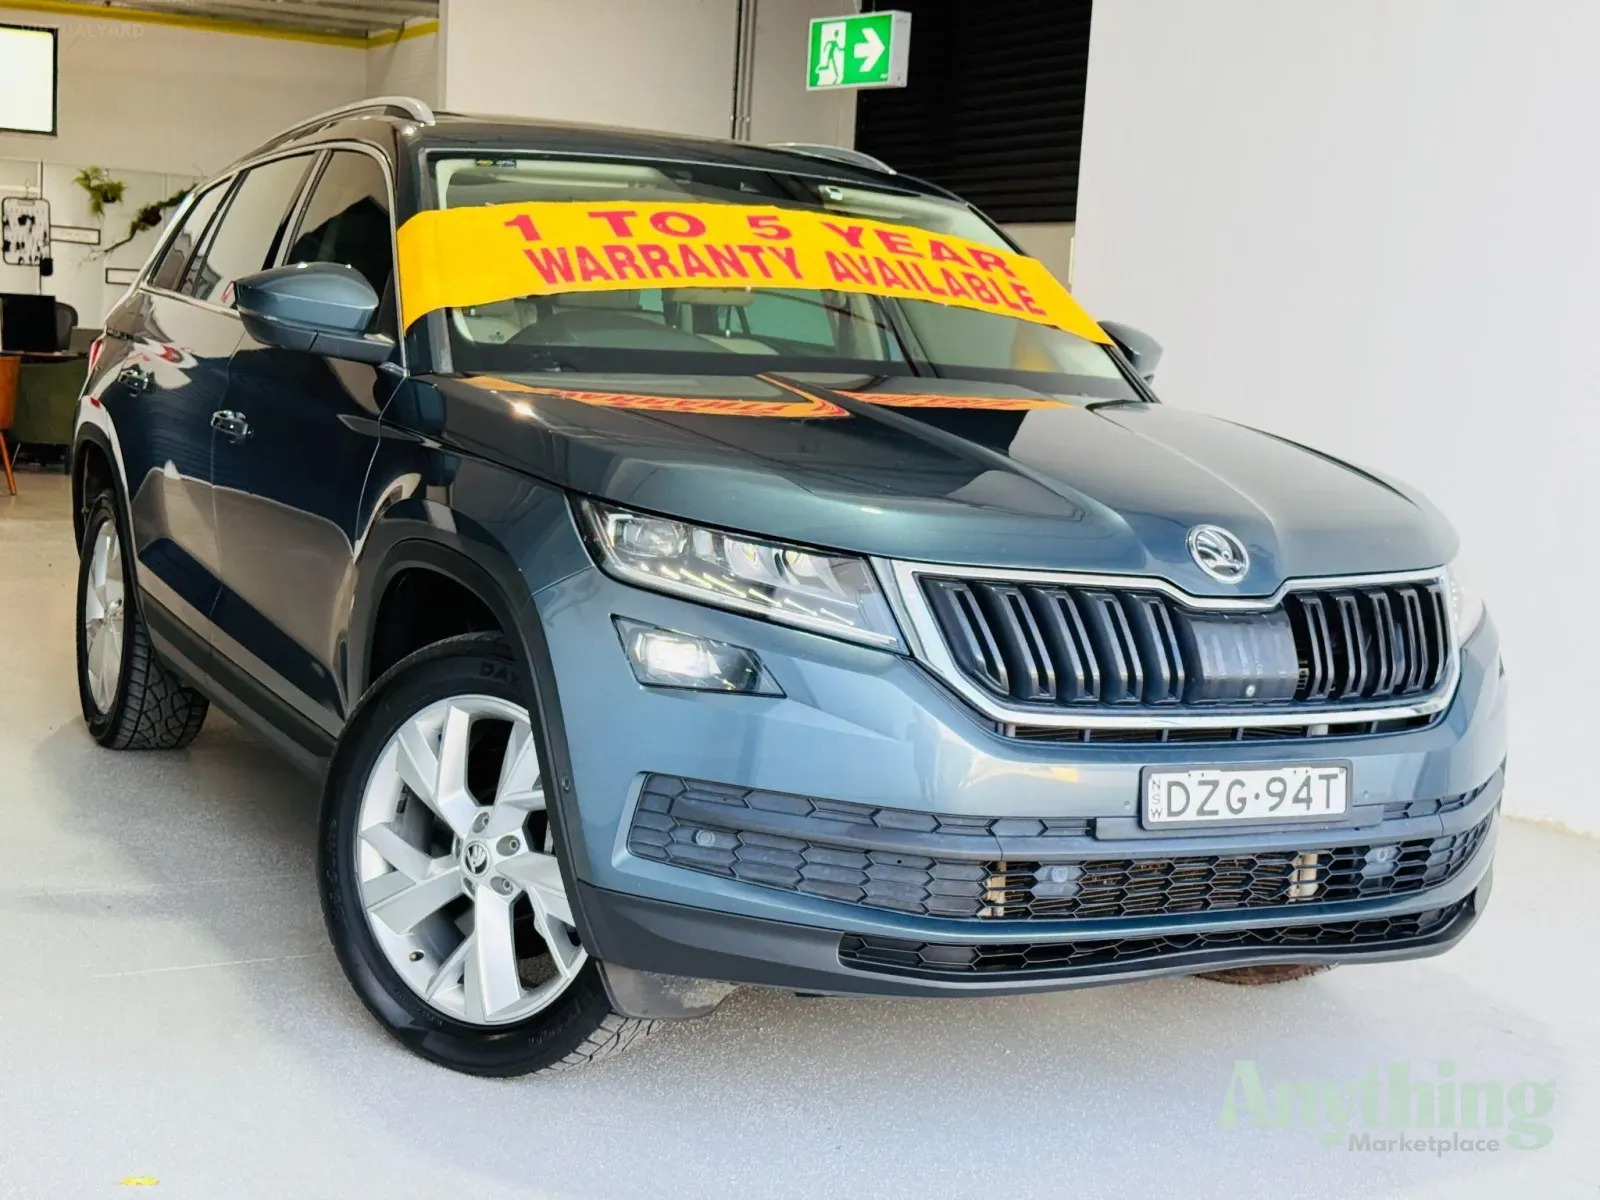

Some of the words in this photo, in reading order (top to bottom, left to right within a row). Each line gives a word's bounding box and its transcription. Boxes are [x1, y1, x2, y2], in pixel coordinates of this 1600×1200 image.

[503, 214, 542, 242] 1
[587, 210, 707, 238] TO
[746, 215, 792, 240] 5
[821, 221, 1016, 278] YEAR
[522, 244, 804, 285] WARRANTY
[824, 250, 1047, 316] AVAILABLE
